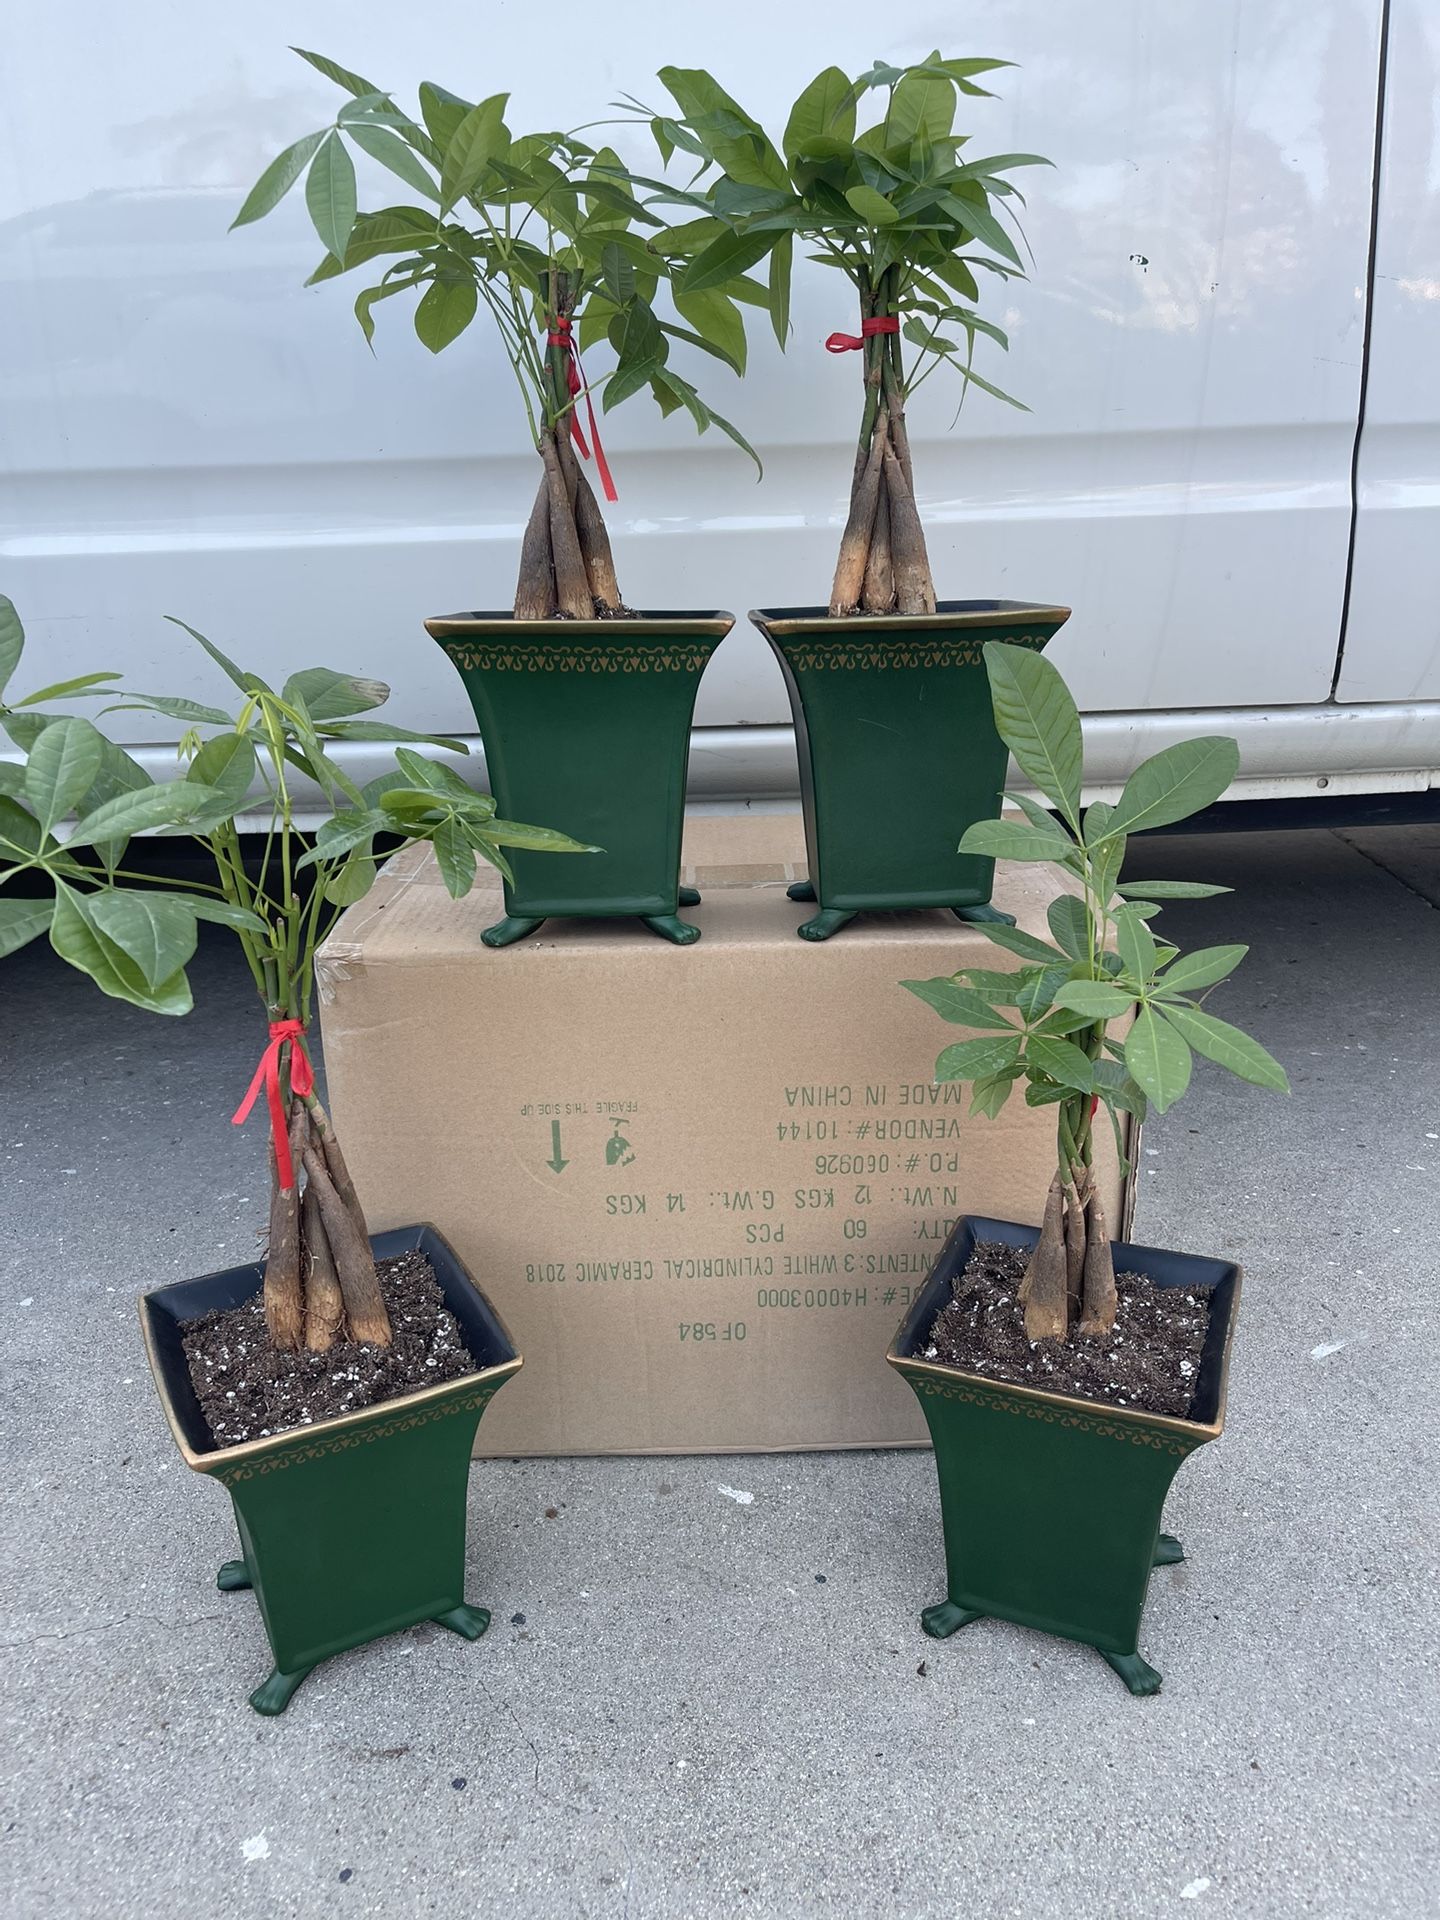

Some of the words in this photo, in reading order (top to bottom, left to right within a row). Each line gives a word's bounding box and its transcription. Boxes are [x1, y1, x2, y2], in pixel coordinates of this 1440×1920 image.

[784, 1086, 852, 1106] CHINA
[865, 1085, 886, 1106] IN
[898, 1084, 962, 1104] MADE
[520, 1104, 534, 1116] UP
[538, 1104, 560, 1115] SIDE
[566, 1102, 588, 1114] THIS
[596, 1102, 638, 1113] FRAGILE
[776, 1120, 838, 1141] 10144
[847, 1119, 960, 1140] VENDOR#:
[815, 1154, 889, 1174] 060926
[896, 1152, 958, 1172] P.O.#:
[606, 1194, 646, 1214] KGS
[666, 1192, 686, 1213] 14
[710, 1190, 774, 1210] G.Wt.:
[794, 1188, 834, 1208] KGS
[854, 1184, 872, 1204] 12
[890, 1186, 957, 1206] N.Wt.:
[746, 1223, 784, 1243] PCS
[843, 1220, 867, 1240] 60
[526, 1264, 566, 1282] 2018
[576, 1260, 653, 1282] CERAMIC
[663, 1256, 773, 1278] CYLINDRICAL
[784, 1254, 838, 1274] WHITE
[844, 1254, 854, 1272] 3
[757, 1287, 868, 1308] H40003000
[678, 1322, 716, 1342] 584
[722, 1322, 746, 1341] OF
